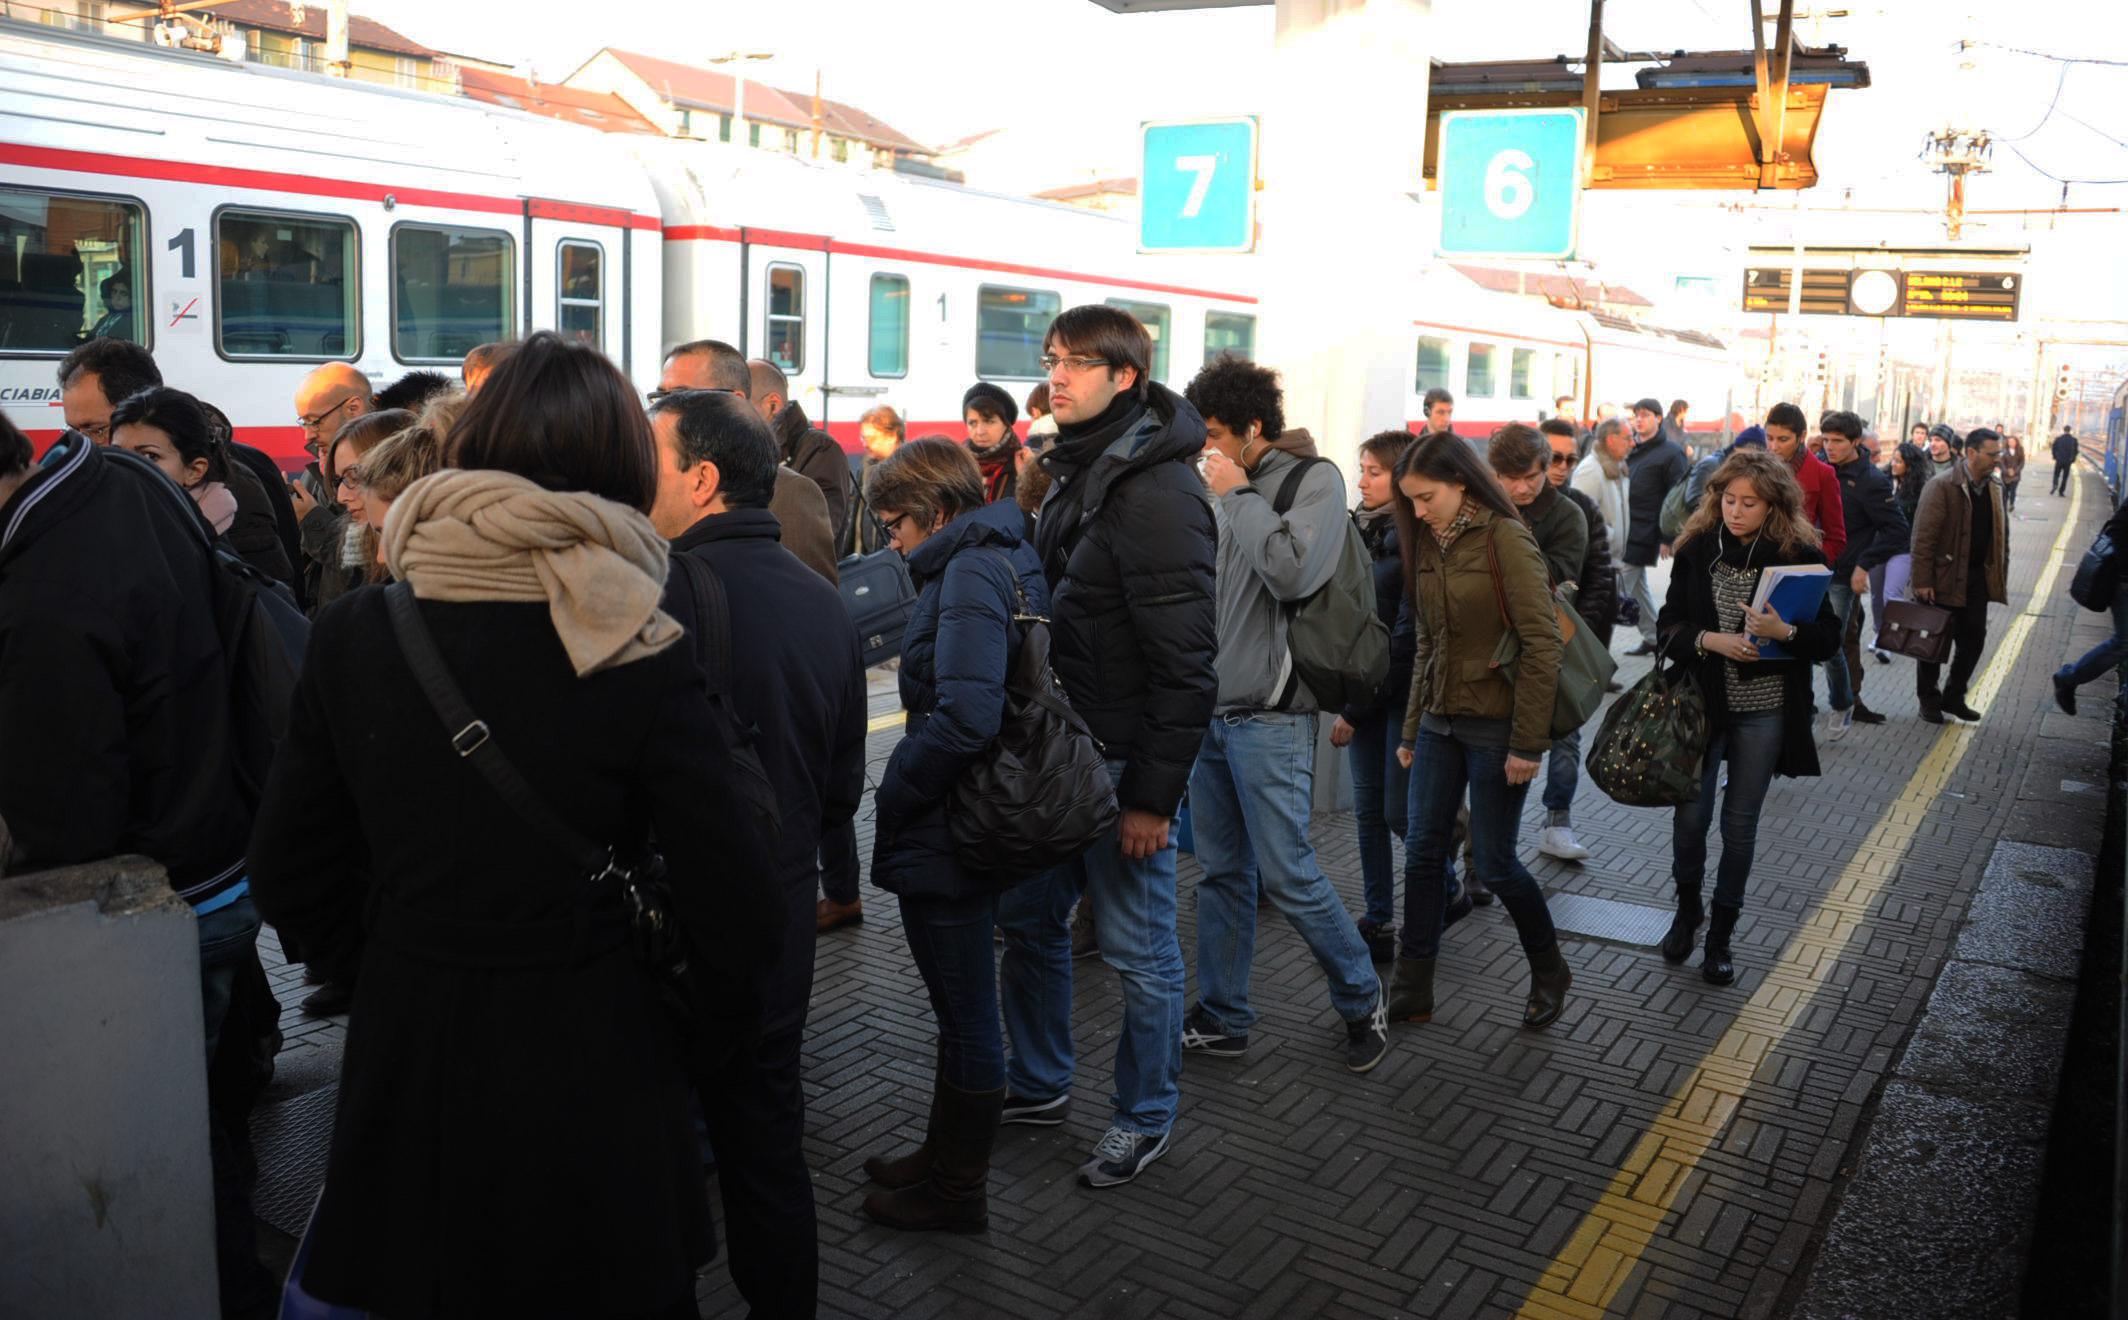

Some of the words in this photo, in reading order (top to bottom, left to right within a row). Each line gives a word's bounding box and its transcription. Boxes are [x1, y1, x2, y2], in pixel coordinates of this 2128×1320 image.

[1175, 155, 1217, 217] 7
[1484, 148, 1534, 219] 6
[168, 228, 195, 278] 1
[1748, 270, 1758, 283] 7
[2002, 276, 2014, 289] 6
[937, 293, 947, 322] 1
